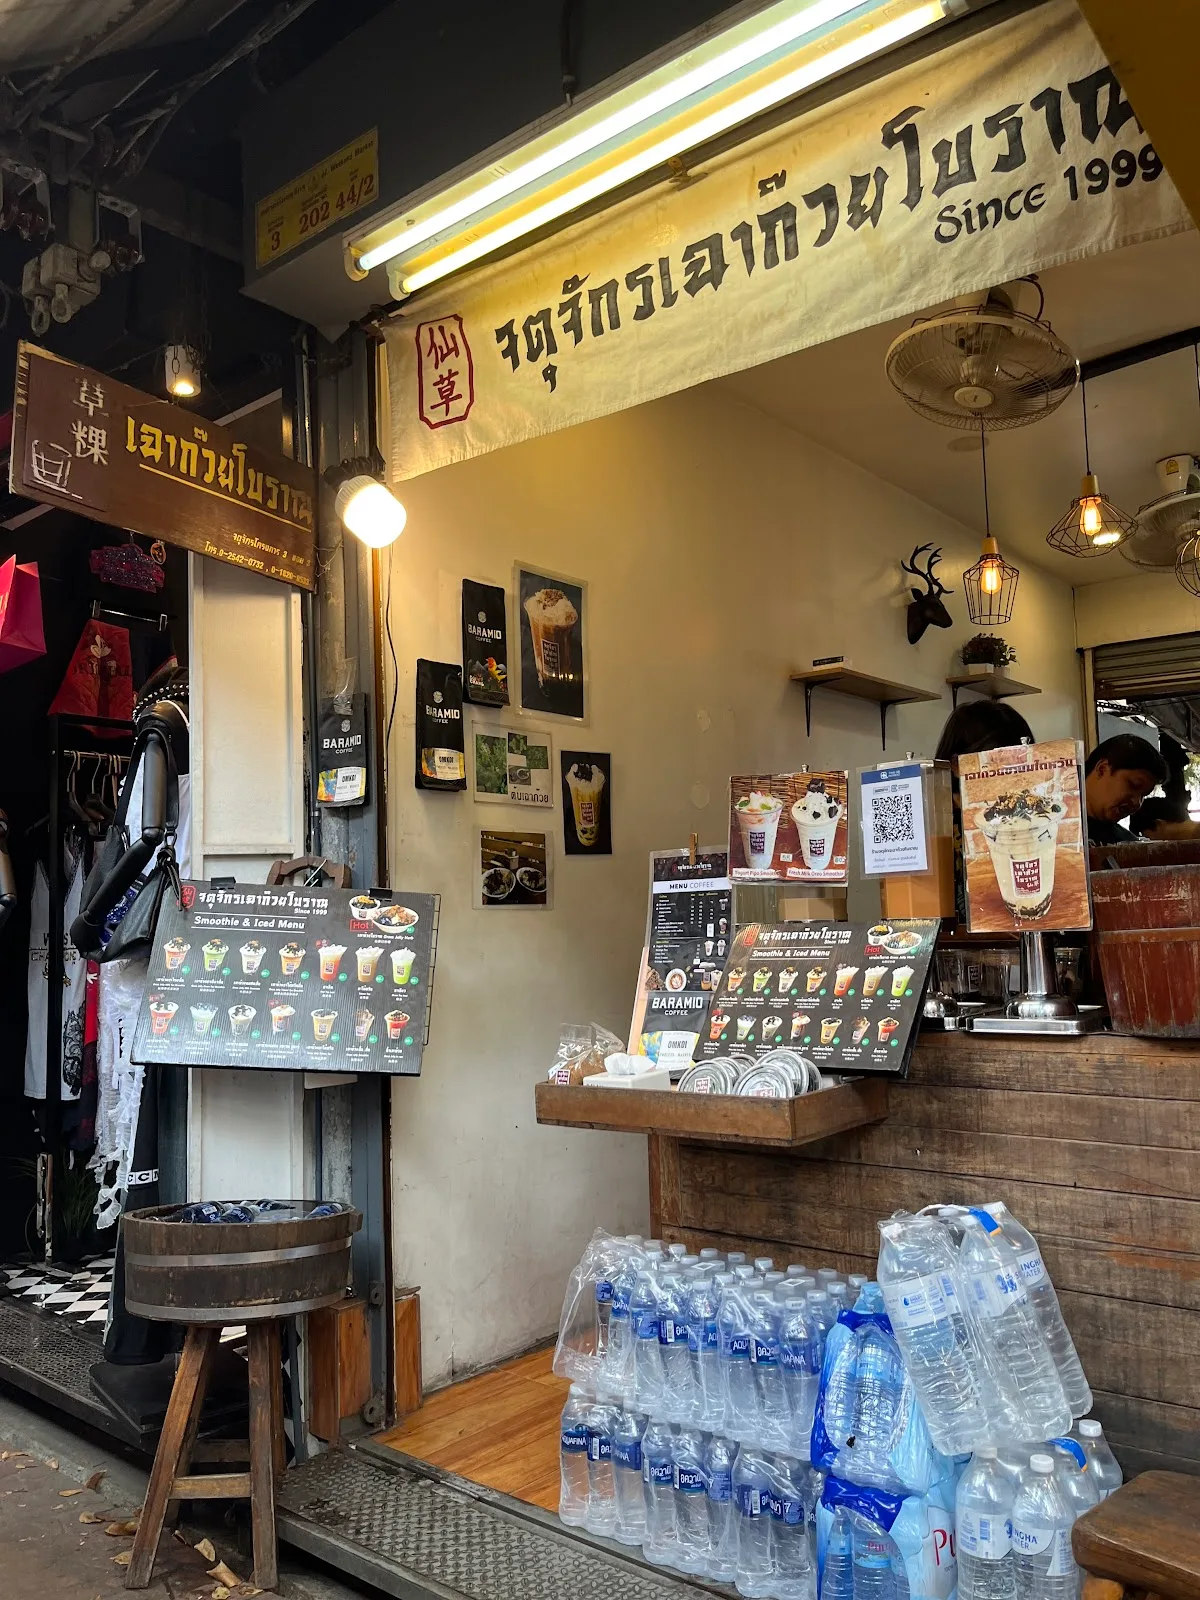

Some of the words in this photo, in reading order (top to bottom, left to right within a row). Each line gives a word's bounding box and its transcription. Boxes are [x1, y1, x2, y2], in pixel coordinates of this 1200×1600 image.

[1064, 143, 1164, 201] 1999
[271, 231, 281, 251] 3
[299, 201, 330, 235] 202
[336, 174, 374, 211] 44/2
[282, 550, 288, 559] 3
[467, 623, 502, 640] BARAMIO
[425, 704, 460, 720] BARAMIO
[323, 734, 362, 749] BARAMIO
[689, 881, 714, 889] COFFEE
[294, 907, 310, 915] Since
[312, 908, 328, 916] 1999
[194, 915, 240, 927] Smoothie
[242, 917, 251, 927] &
[253, 917, 275, 928] Iced
[278, 919, 305, 930] Menu
[353, 921, 369, 929] Hot
[752, 949, 783, 957] Smoothie
[785, 949, 791, 957] &
[792, 949, 808, 957] Iced
[810, 949, 831, 957] Menu
[652, 996, 704, 1009] BARAMIO
